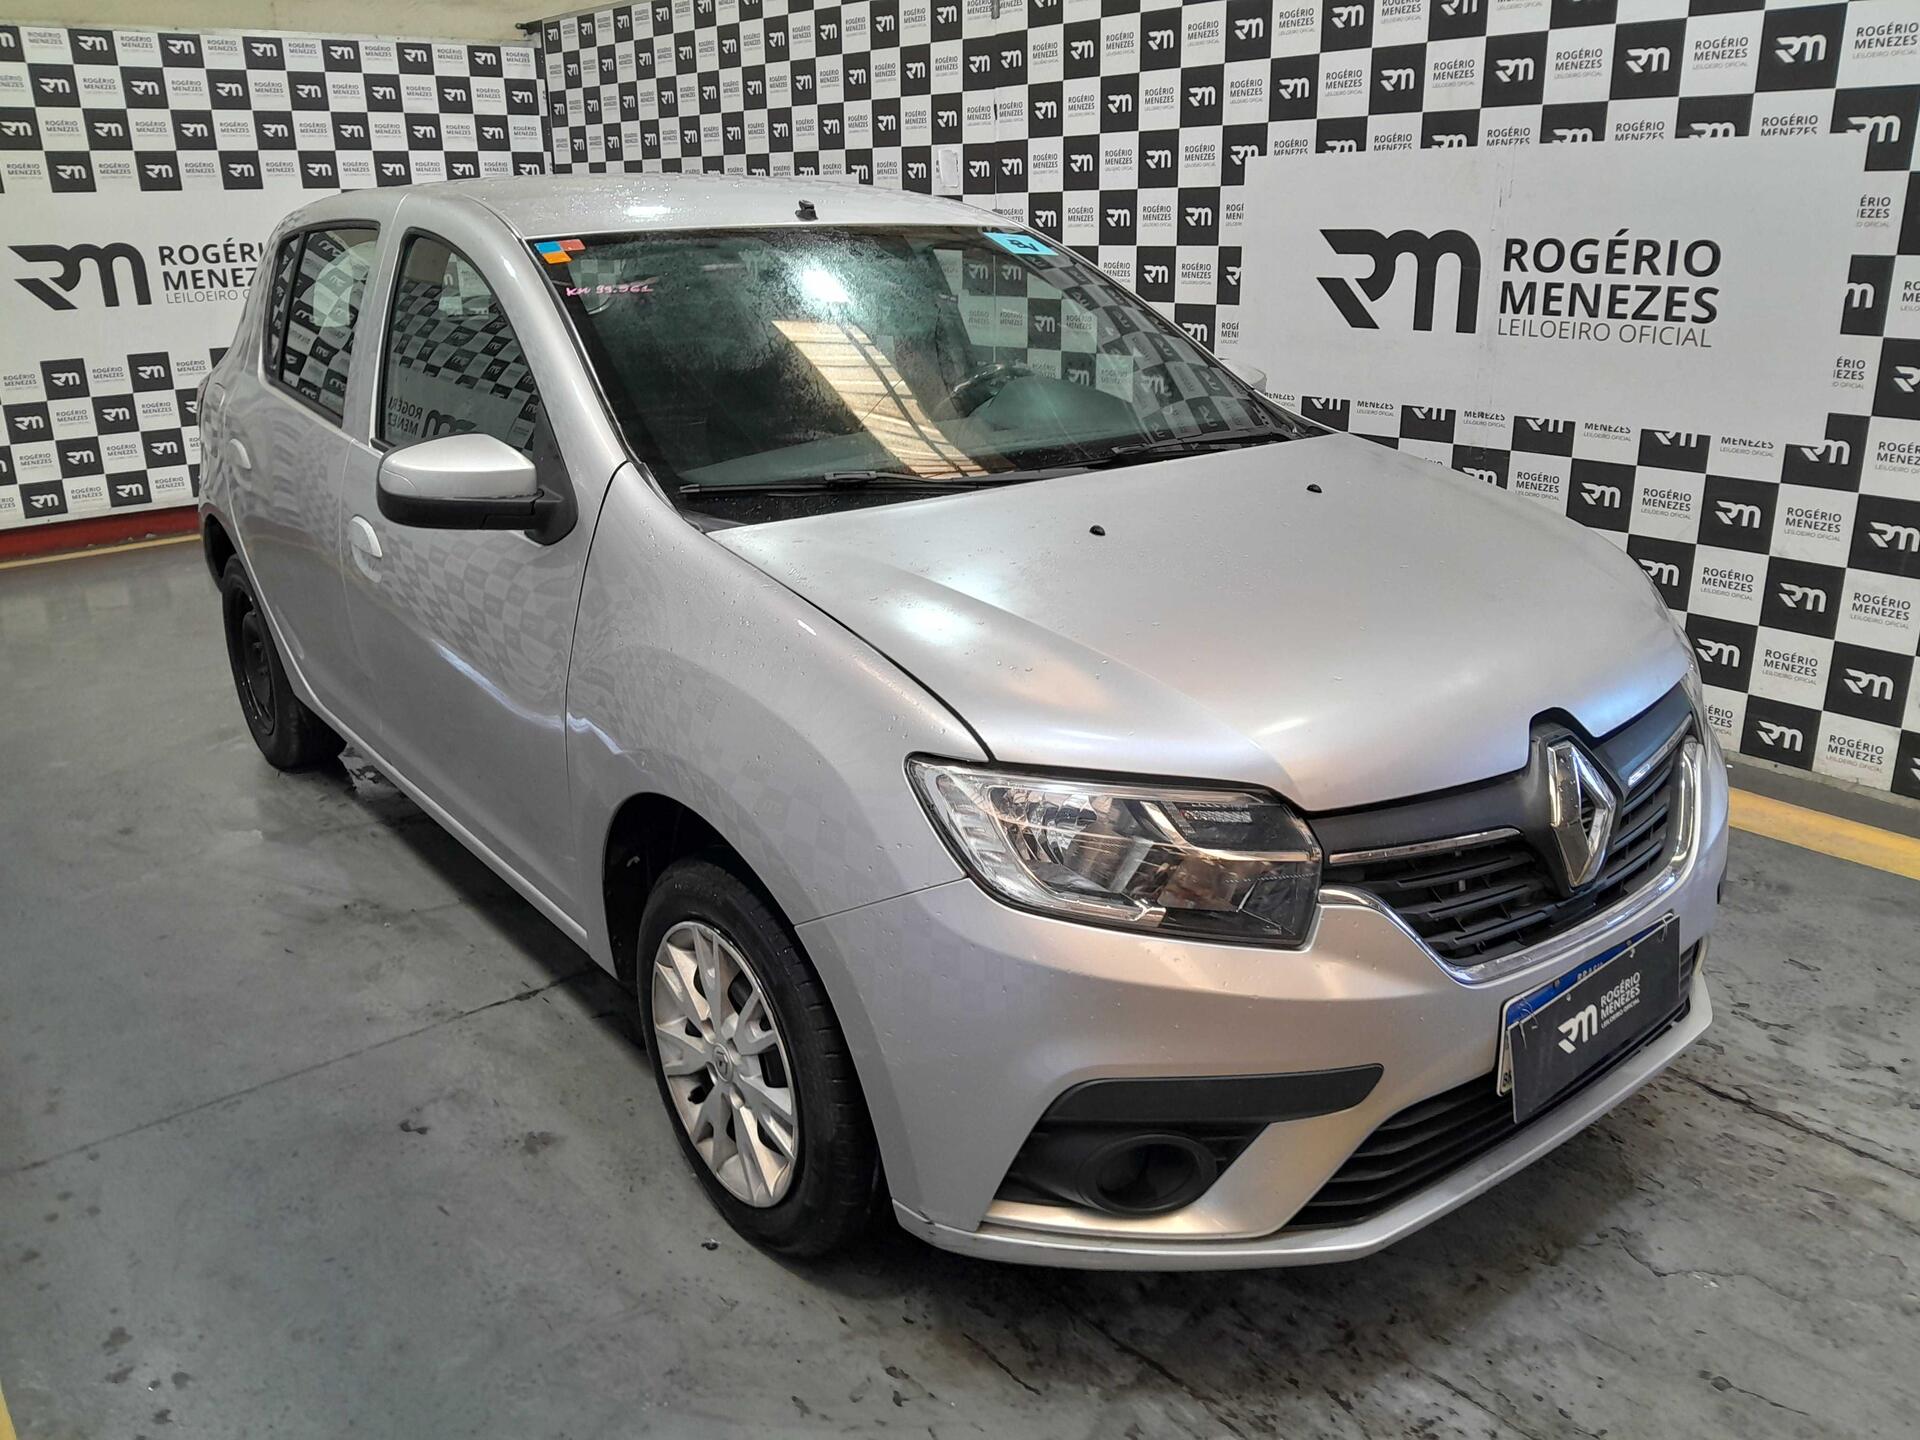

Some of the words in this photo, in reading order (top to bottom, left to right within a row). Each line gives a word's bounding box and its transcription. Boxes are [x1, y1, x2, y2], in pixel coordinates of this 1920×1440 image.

[903, 6, 926, 18] ROGÉRIO
[1279, 7, 1315, 20] ROGÉRIO
[1382, 3, 1422, 16] MENEZES
[903, 14, 926, 25] MENEZES
[1188, 20, 1219, 31] ROGÉRIO
[1278, 16, 1315, 29] MENEZES
[1187, 28, 1219, 40] MENEZES
[1856, 22, 1920, 37] ROGÉRIO
[1106, 31, 1134, 42] ROGÉRIO
[1694, 36, 1749, 49] ROGÉRIO
[1854, 35, 1918, 49] MENEZES
[1033, 41, 1058, 51] ROGÉRIO
[1105, 39, 1134, 51] MENEZES
[1032, 49, 1058, 59] MENEZES
[1555, 47, 1603, 61] ROGÉRIO
[1693, 48, 1748, 62] MENEZES
[875, 61, 896, 72] ROGÉRIO
[1433, 58, 1475, 72] ROGÉRIO
[1554, 58, 1603, 71] MENEZES
[874, 69, 896, 79] MENEZES
[1326, 69, 1363, 81] ROGÉRIO
[1433, 68, 1475, 81] MENEZES
[1230, 78, 1263, 90] ROGÉRIO
[1325, 77, 1362, 90] MENEZES
[1144, 86, 1174, 97] ROGÉRIO
[1229, 86, 1263, 97] MENEZES
[1068, 93, 1094, 104] ROGÉRIO
[1144, 94, 1174, 105] MENEZES
[967, 104, 991, 114] ROGÉRIO
[999, 101, 1023, 111] ROGÉRIO
[1067, 101, 1095, 111] MENEZES
[905, 109, 927, 118] ROGÉRIO
[966, 112, 992, 121] MENEZES
[999, 108, 1023, 118] MENEZES
[905, 116, 927, 126] MENEZES
[1615, 119, 1665, 132] ROGÉRIO
[1761, 113, 1818, 127] ROGÉRIO
[1374, 132, 1413, 144] ROGÉRIO
[1487, 127, 1531, 138] ROGÉRIO
[1185, 143, 1215, 153] ROGÉRIO
[1274, 138, 1308, 150] ROGÉRIO
[1032, 152, 1058, 162] ROGÉRIO
[1105, 147, 1133, 158] ROGÉRIO
[1184, 152, 1215, 162] MENEZES
[1032, 160, 1058, 169] MENEZES
[1105, 156, 1133, 166] MENEZES
[1067, 206, 1094, 215] ROGÉRIO
[1143, 203, 1172, 214] ROGÉRIO
[1067, 213, 1094, 222] MENEZES
[1142, 212, 1172, 221] MENEZES
[159, 238, 263, 266] ROGÉRI
[1503, 228, 1722, 278] ROGÉRIO
[1103, 261, 1131, 270] ROGÉRIO
[1182, 262, 1212, 272] ROGÉRIO
[1181, 270, 1212, 279] MENEZES
[166, 289, 239, 304] LEILOEIRO
[1499, 280, 1720, 324] MENEZES
[1497, 318, 1611, 342] LEILOEIRO
[1618, 323, 1712, 348] OFICIAL
[92, 366, 123, 376] ROGÉRIO
[93, 370, 124, 380] MENEZES
[3, 373, 36, 384] ROGÉRIO
[3, 378, 37, 387] MENEZES
[56, 409, 87, 418] ROGÉRIO
[57, 415, 89, 423] MENEZES
[107, 443, 136, 452] ROGÉRIO
[107, 448, 138, 457] MENEZES
[1878, 440, 1920, 455] ROGÉR
[19, 452, 51, 462] ROGÉRIO
[20, 458, 53, 467] MENEZES
[1876, 453, 1920, 466] MENEZ
[1516, 470, 1560, 485] ROGÉRIO
[1515, 480, 1559, 494] MENEZES
[1643, 487, 1692, 502] ROGÉRIO
[1642, 498, 1691, 512] MENEZES
[1786, 507, 1842, 523] ROGÉRIO
[1785, 518, 1841, 533] MENEZES
[1703, 566, 1754, 583] ROGÉRIO
[1701, 577, 1753, 593] MENEZES
[1853, 592, 1911, 610] ROGÉRIO
[1852, 603, 1910, 621] MENEZES
[1764, 648, 1818, 667] ROGÉRIO
[1763, 658, 1817, 677] MENEZES
[1829, 734, 1885, 755] ROGÉRIO
[1828, 743, 1883, 765] MENEZES
[1600, 972, 1641, 1008] ROGÉRIO
[1600, 983, 1641, 1020] MENEZES
